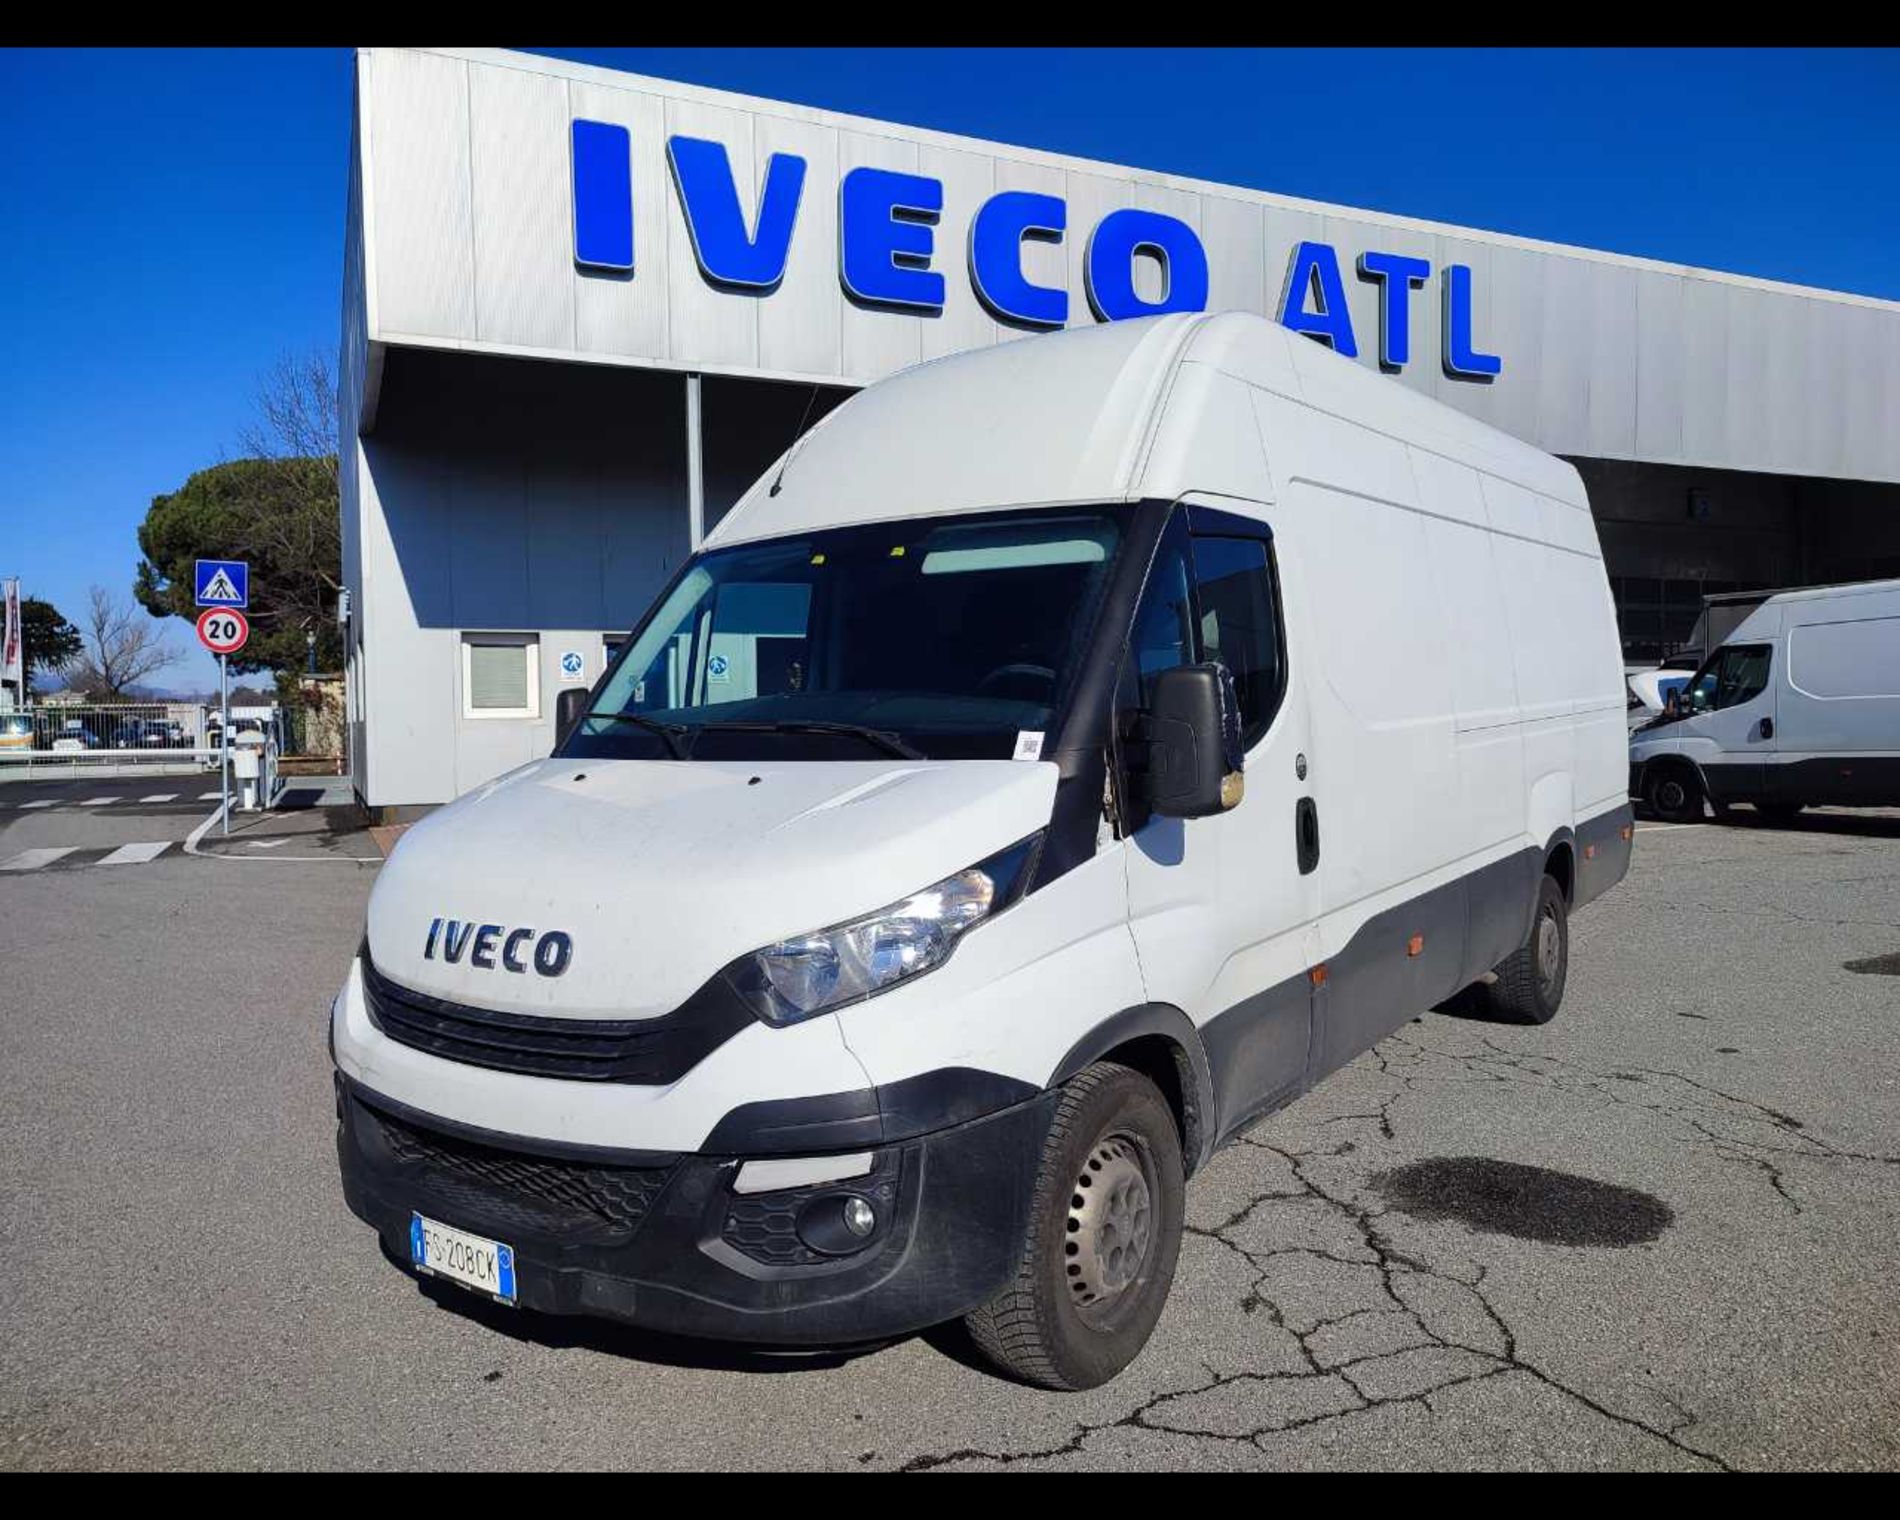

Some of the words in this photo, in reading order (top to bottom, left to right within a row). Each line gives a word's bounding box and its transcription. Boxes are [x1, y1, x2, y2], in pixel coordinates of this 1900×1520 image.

[571, 118, 1209, 325] IVECO
[1277, 241, 1501, 378] ATL
[209, 620, 236, 639] 20
[424, 918, 573, 977] IVECO
